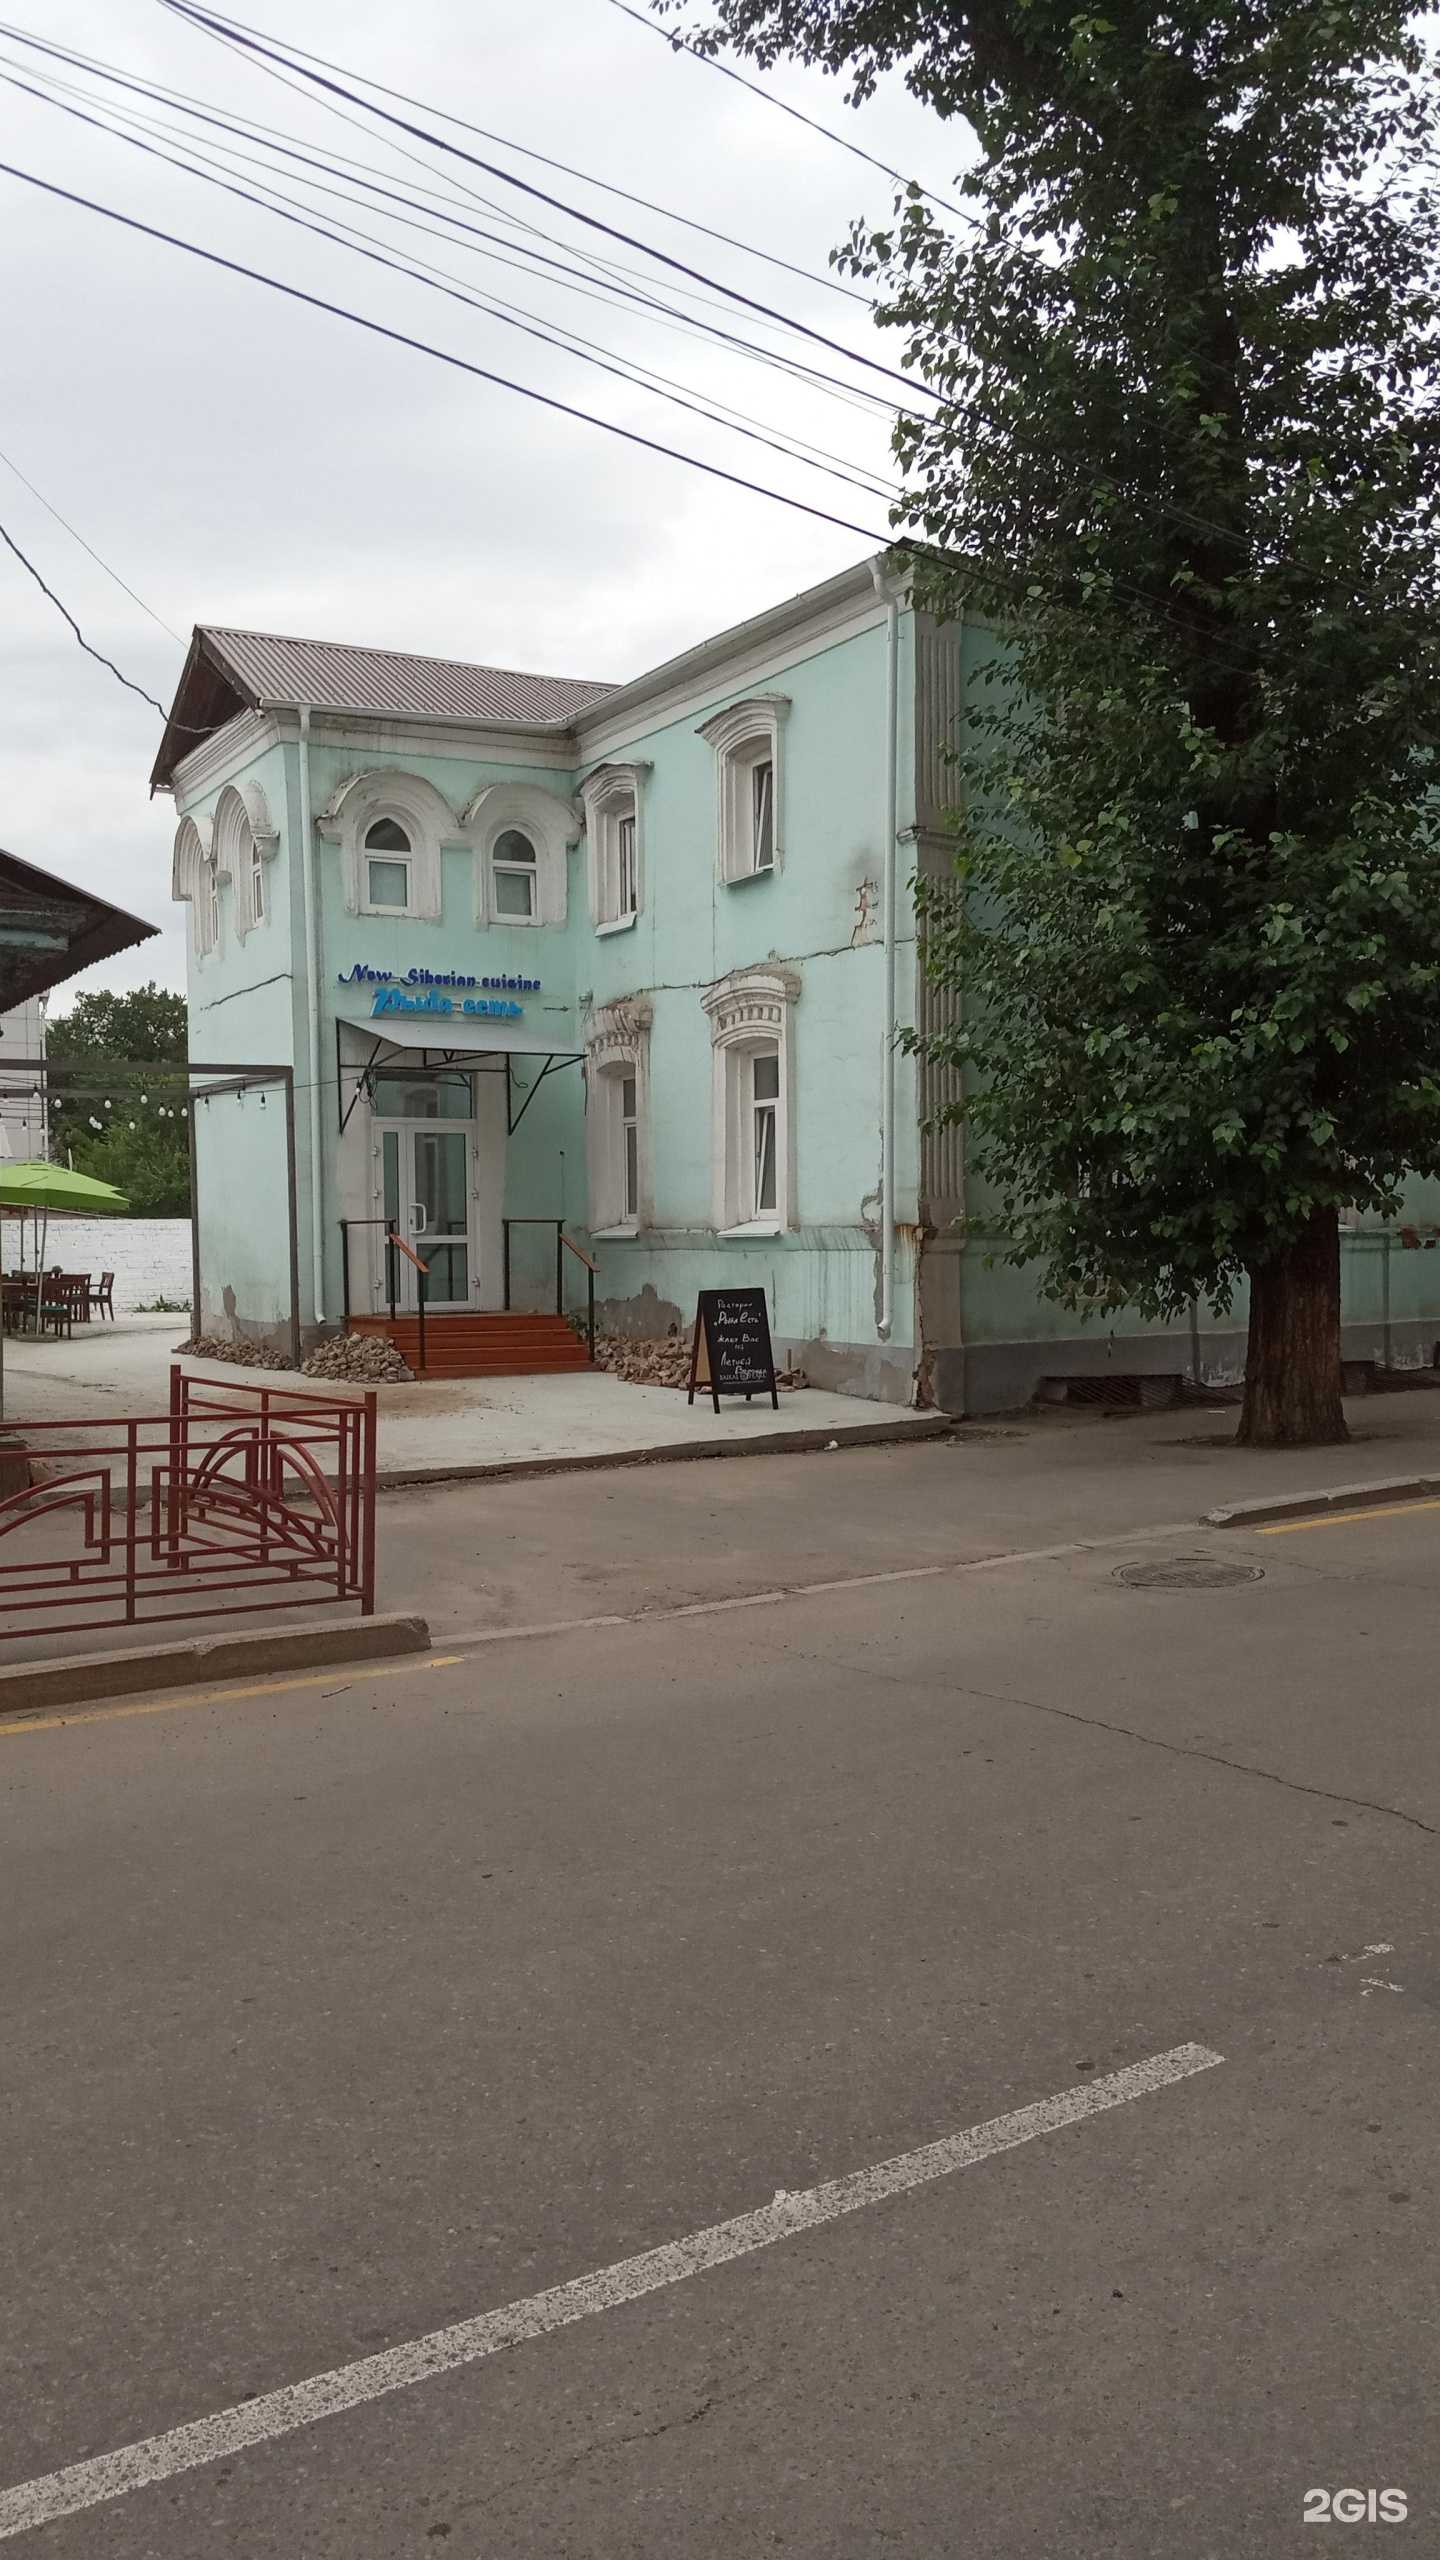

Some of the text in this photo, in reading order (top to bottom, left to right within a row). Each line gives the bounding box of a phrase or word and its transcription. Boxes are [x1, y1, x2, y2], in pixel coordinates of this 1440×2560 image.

[338, 964, 541, 991] New Siberian cuisine
